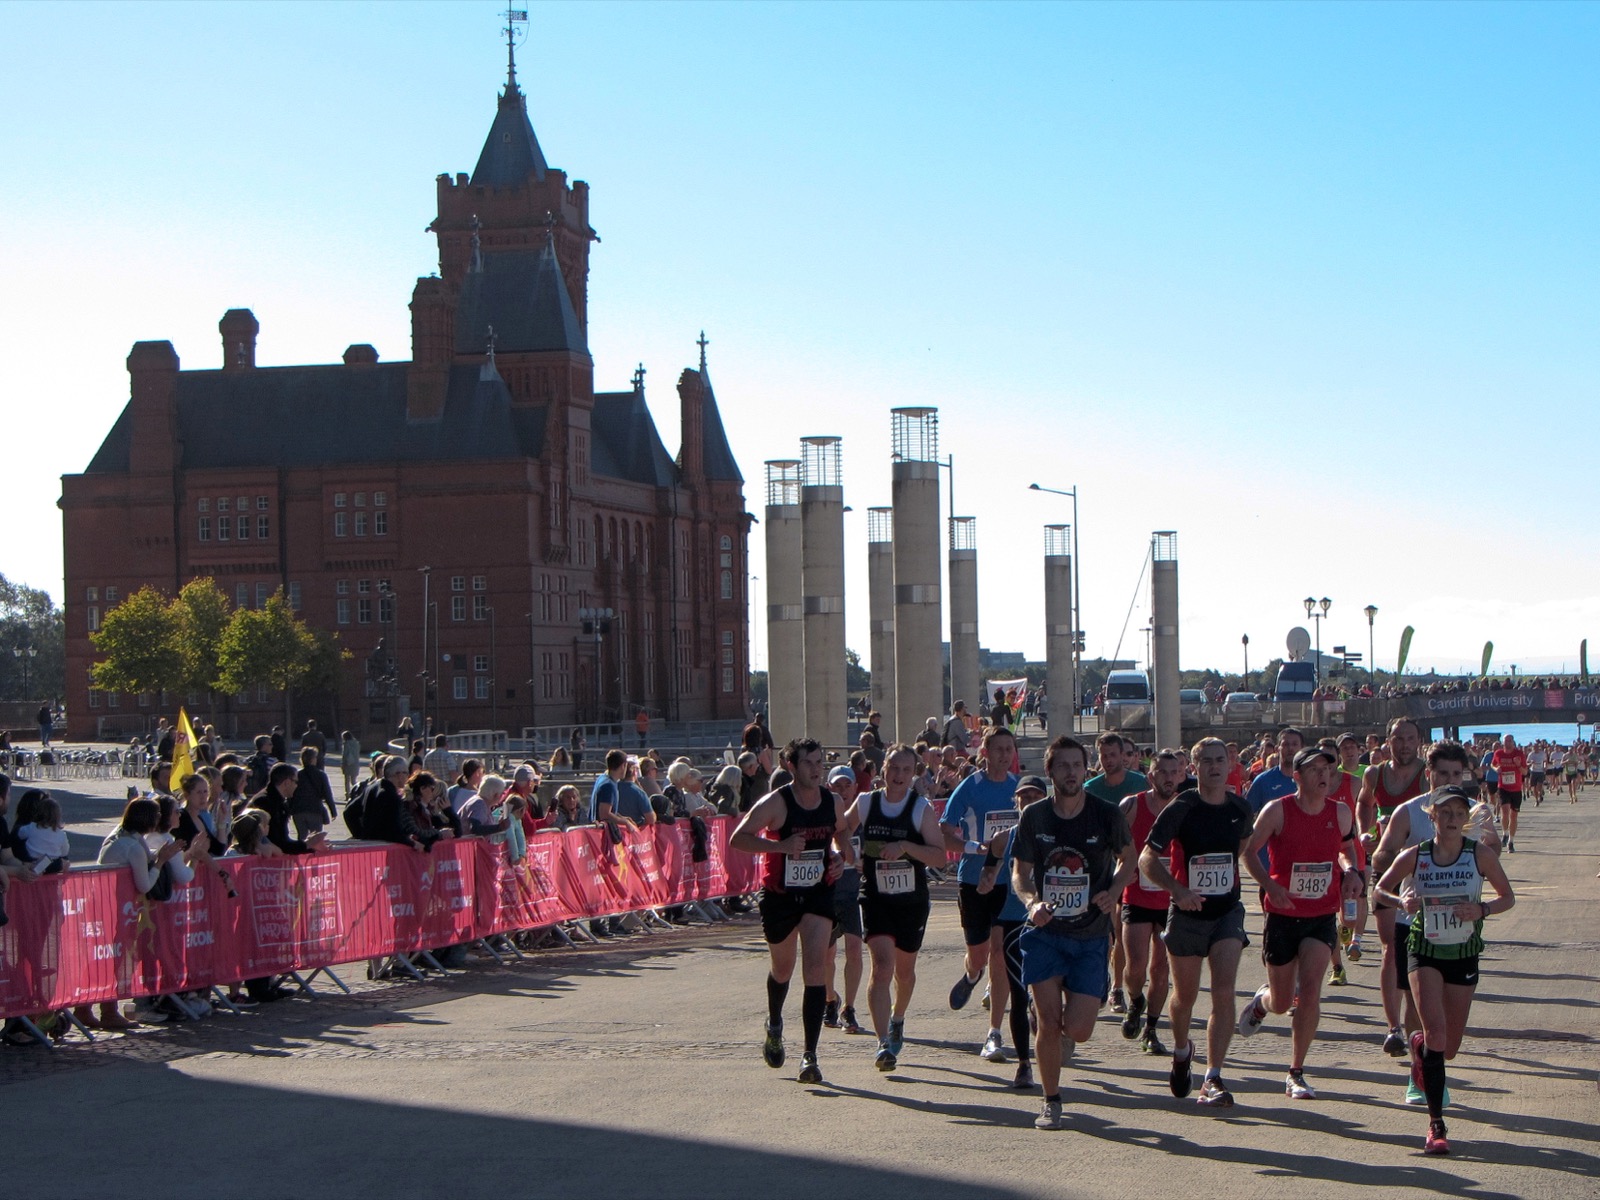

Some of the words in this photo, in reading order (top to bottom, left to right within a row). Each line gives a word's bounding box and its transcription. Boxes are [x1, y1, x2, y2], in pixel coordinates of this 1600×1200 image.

[1428, 695, 1470, 710] Cardiff
[1473, 693, 1534, 707] University
[883, 874, 908, 889] 1911
[1197, 871, 1228, 887] 2516
[1418, 872, 1433, 881] PARC
[1435, 871, 1453, 880] BRYN
[1455, 870, 1473, 880] BACH
[1049, 892, 1082, 908] 3503
[94, 942, 122, 960] ICONIC
